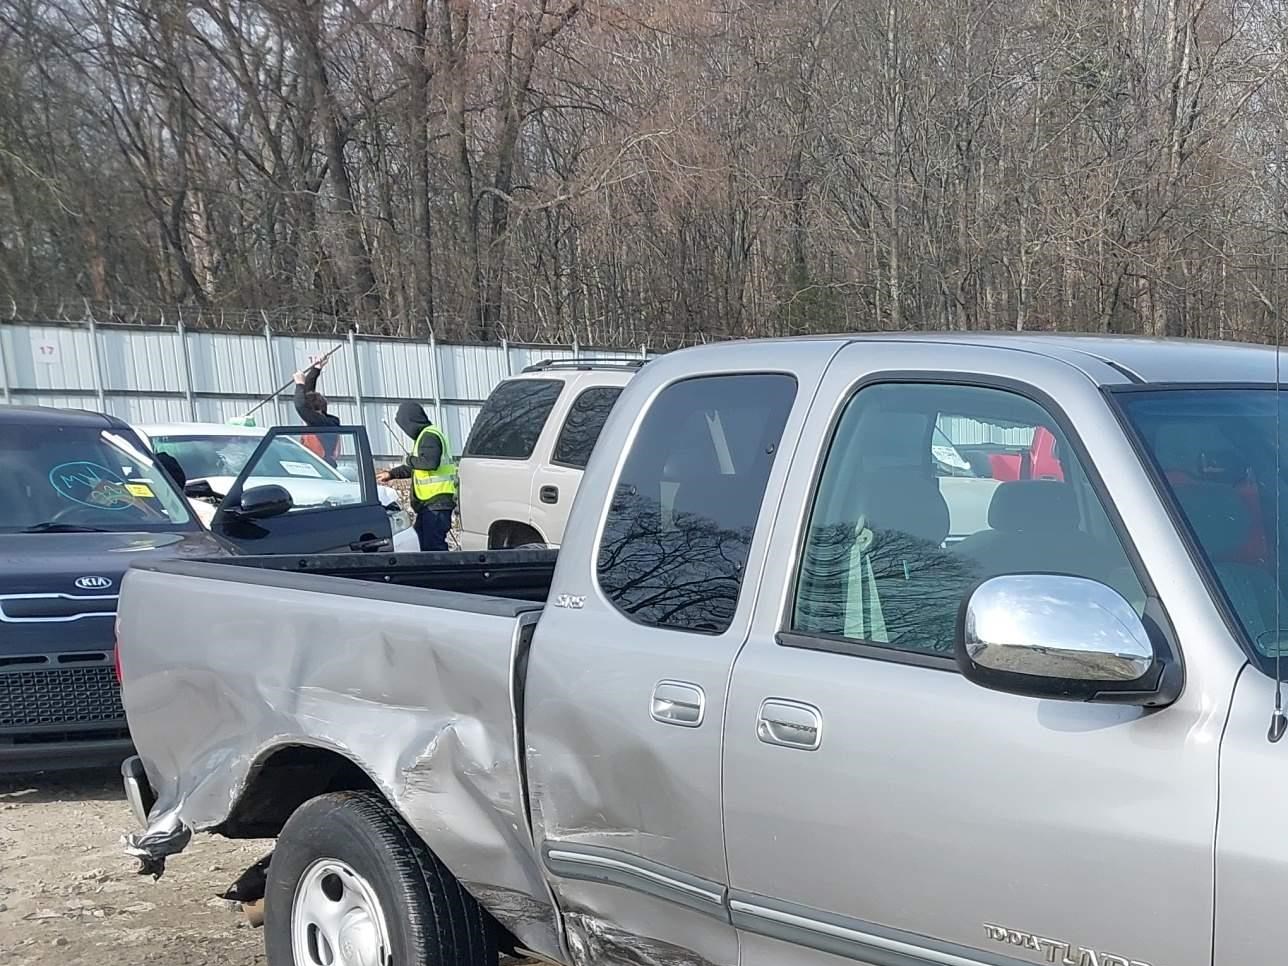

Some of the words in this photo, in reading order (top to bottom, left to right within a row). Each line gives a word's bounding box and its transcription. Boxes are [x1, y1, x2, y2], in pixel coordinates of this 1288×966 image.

[40, 345, 55, 355] 17
[81, 576, 108, 586] KIA
[983, 922, 1042, 951] TOYOTA
